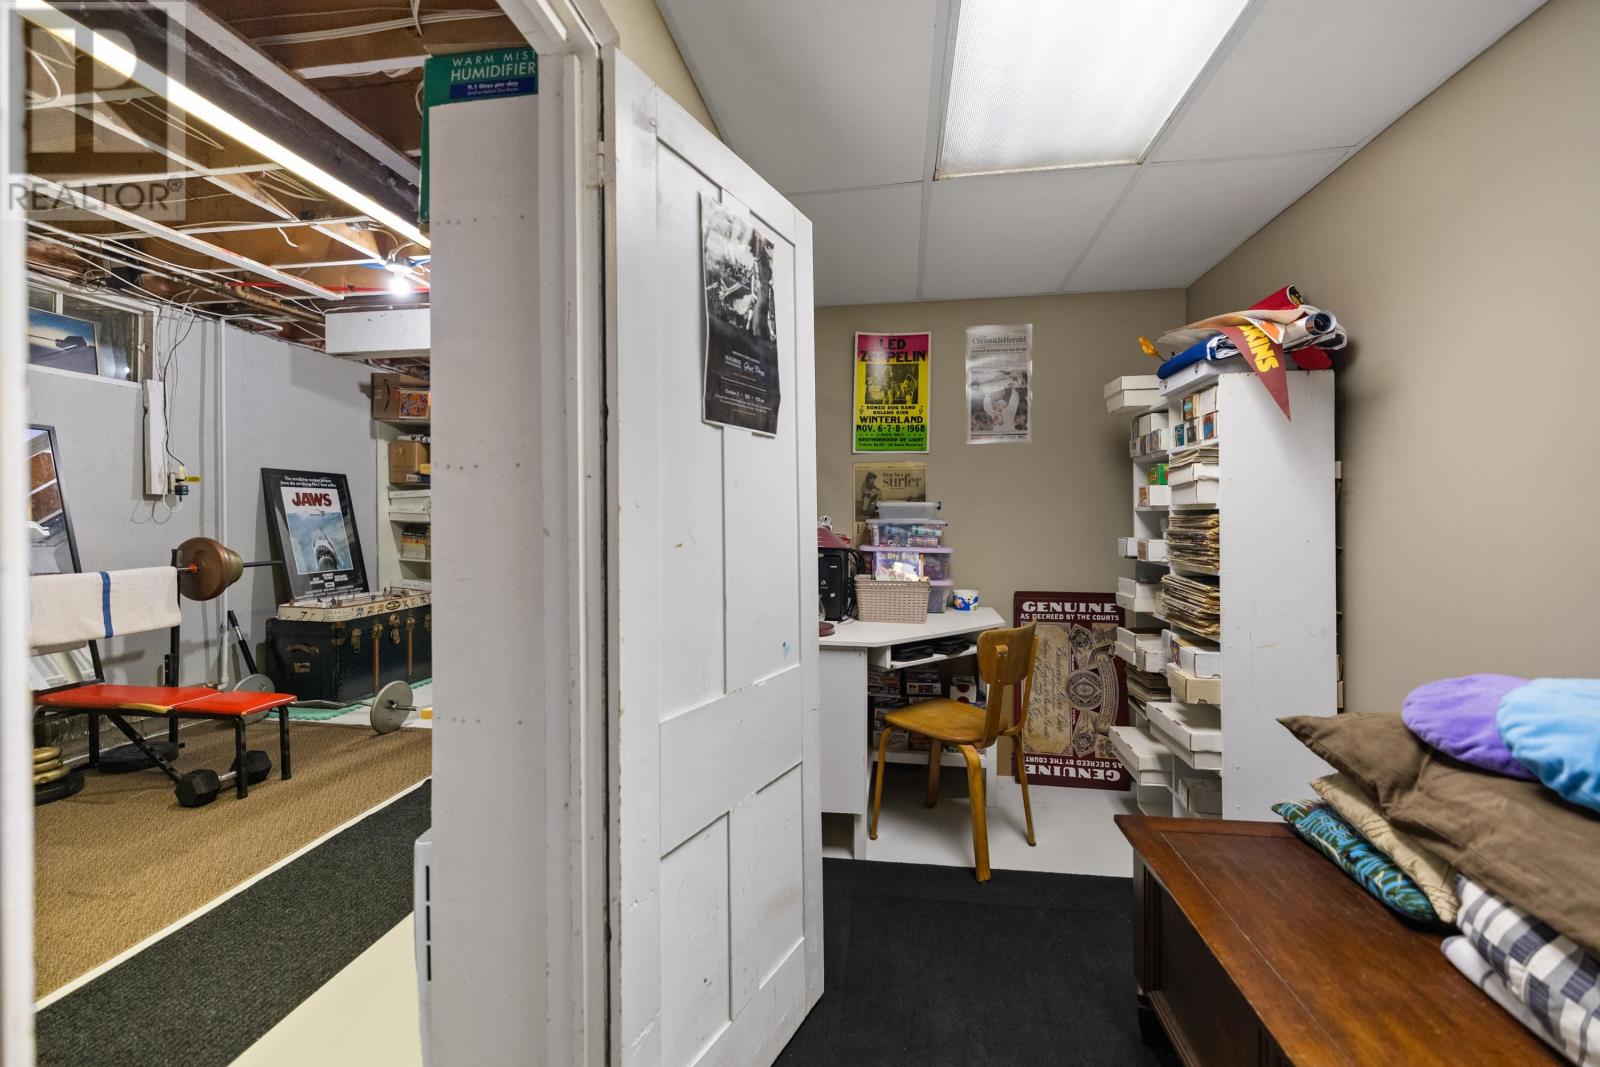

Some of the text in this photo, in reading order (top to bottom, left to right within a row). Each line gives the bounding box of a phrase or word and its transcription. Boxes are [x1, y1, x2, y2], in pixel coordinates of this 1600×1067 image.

[452, 55, 495, 67] WARM
[451, 62, 536, 82] HUMIDIFIER
[859, 415, 924, 424] WINTERLAND
[856, 424, 875, 432] NOV.
[882, 473, 922, 488] surfer
[291, 492, 332, 507] JAWS
[1022, 601, 1117, 613] GENUINE
[1024, 764, 1121, 782] GENUINE
